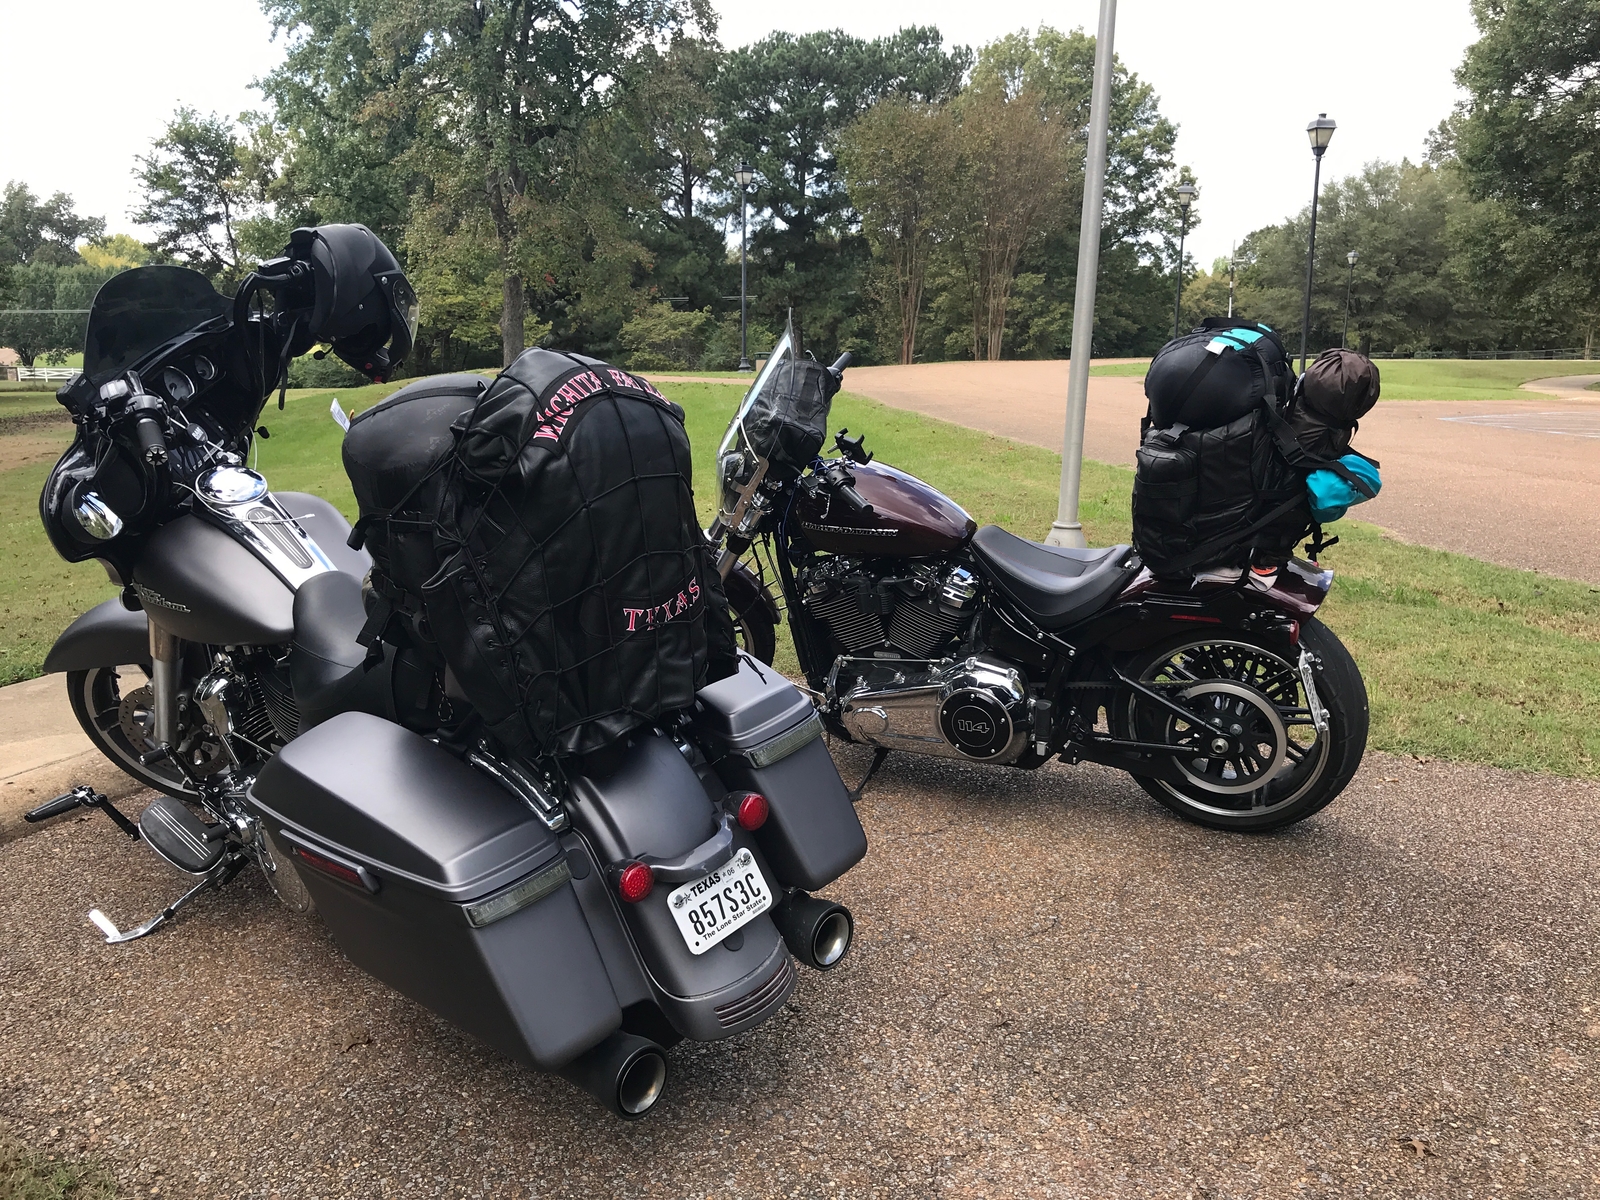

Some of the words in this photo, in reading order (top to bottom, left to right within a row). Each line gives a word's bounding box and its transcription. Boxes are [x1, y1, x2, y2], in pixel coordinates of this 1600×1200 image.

[533, 370, 610, 442] WICHITA
[607, 369, 671, 406] FAL
[623, 576, 700, 631] TEXAS
[958, 720, 990, 734] 114
[688, 873, 762, 936] 857S3C
[690, 872, 721, 897] TEXAS
[702, 930, 716, 941] The
[716, 920, 732, 932] Lone
[732, 910, 746, 921] Star
[746, 898, 762, 912] State
